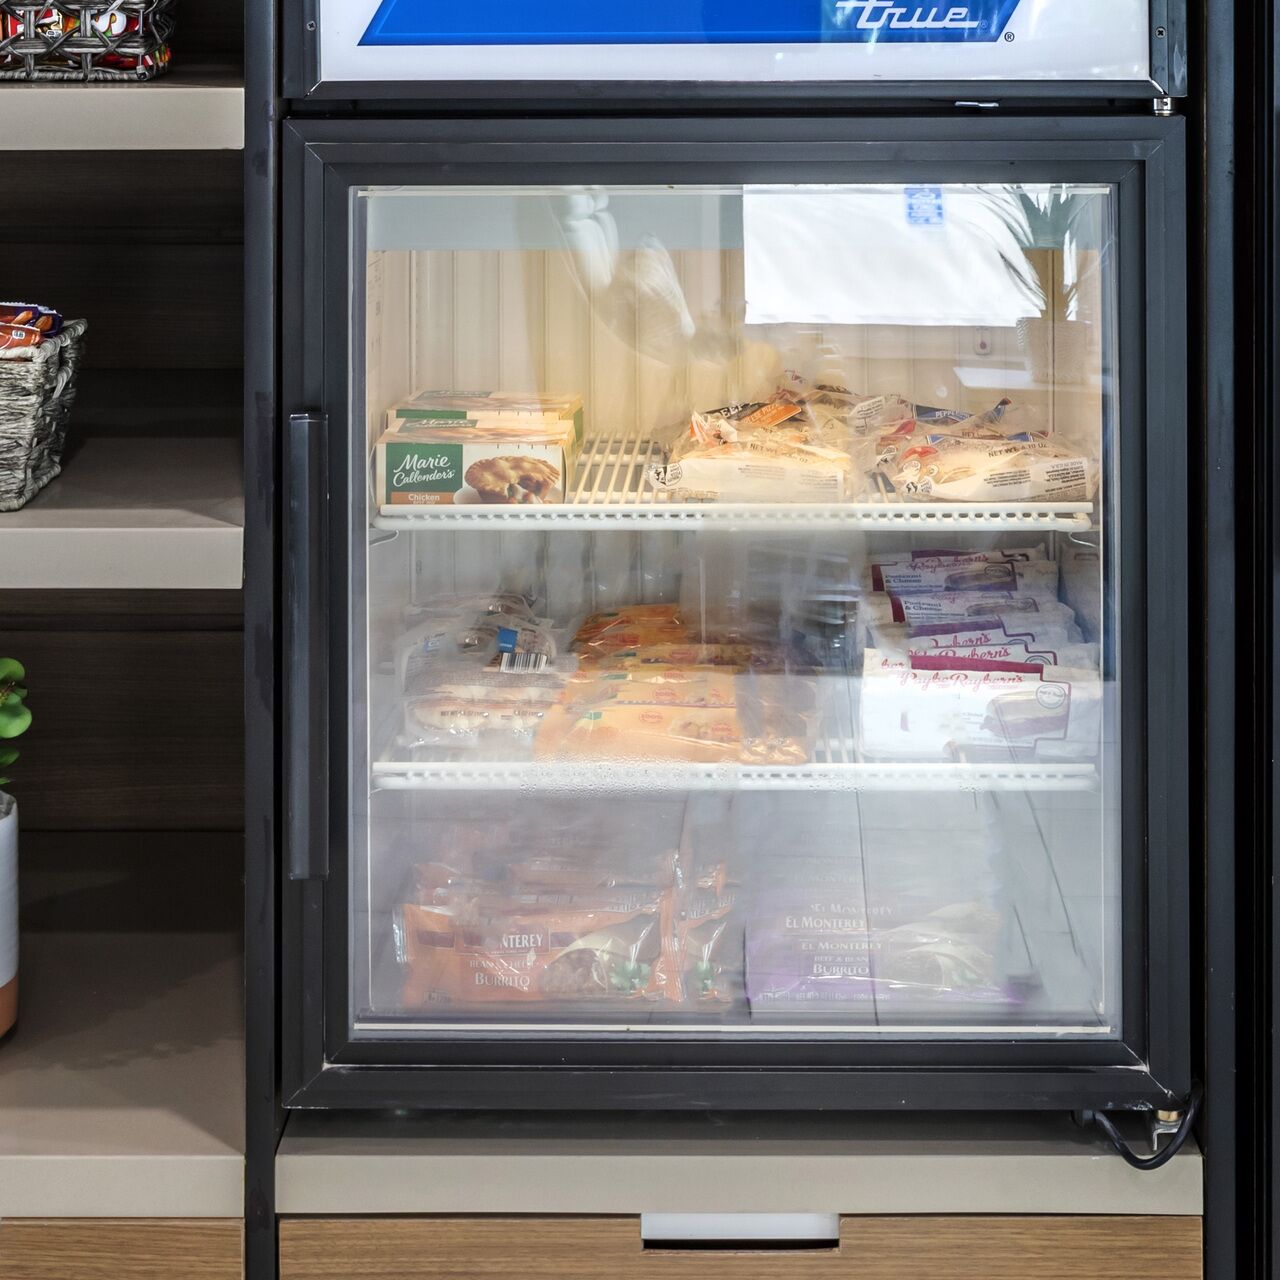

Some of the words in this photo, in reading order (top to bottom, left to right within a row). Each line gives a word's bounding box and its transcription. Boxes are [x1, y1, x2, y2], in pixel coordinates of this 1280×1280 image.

[403, 454, 451, 472] Marie
[393, 469, 455, 487] Callender's
[408, 493, 440, 502] Chicken
